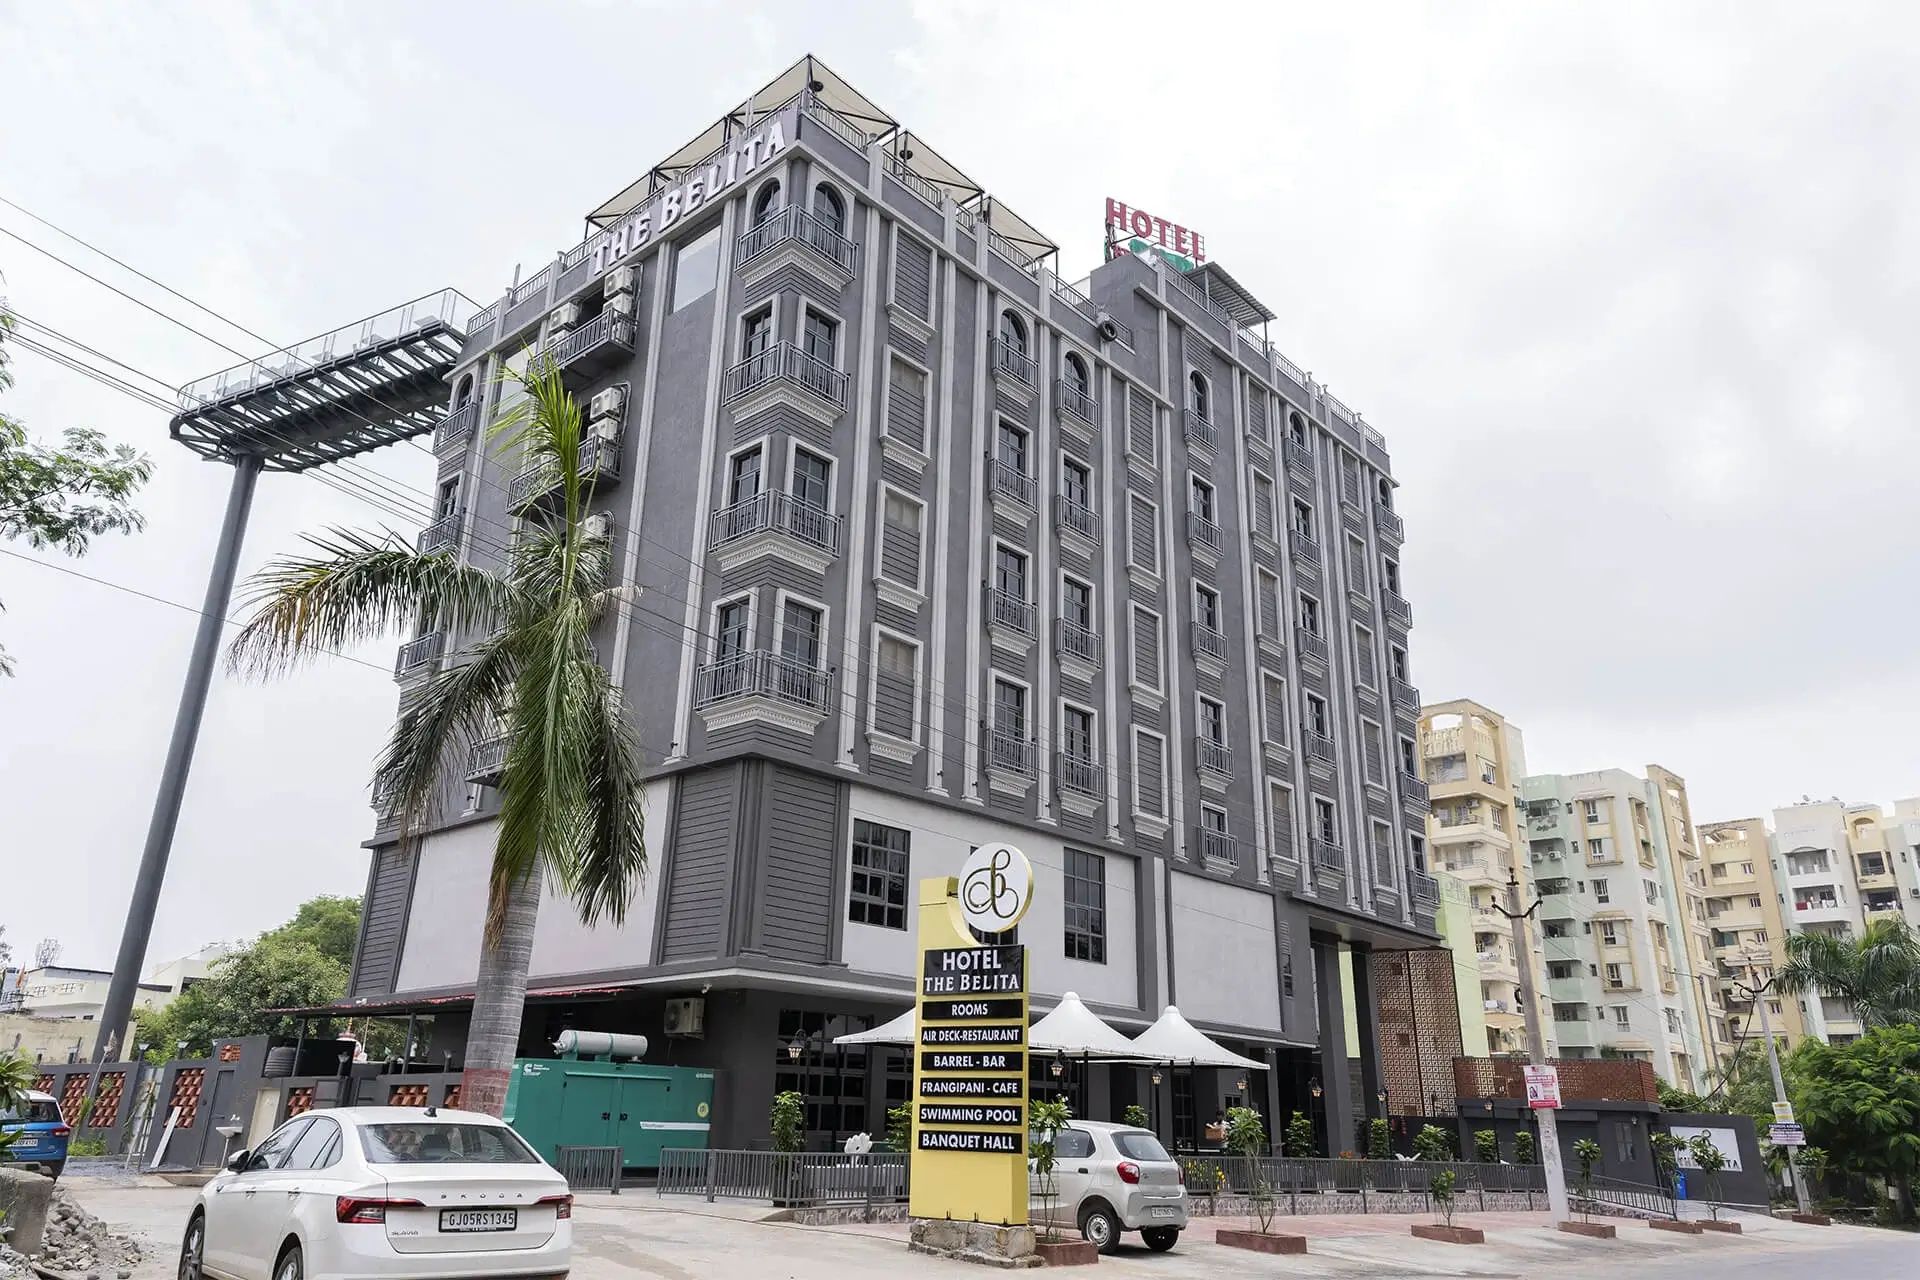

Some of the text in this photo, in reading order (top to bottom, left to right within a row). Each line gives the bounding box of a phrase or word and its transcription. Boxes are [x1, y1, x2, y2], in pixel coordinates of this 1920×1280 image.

[593, 121, 786, 276] THE BELITA
[1105, 197, 1206, 262] HOTEL
[942, 949, 1002, 971] HOTEL
[924, 973, 1019, 992] THE BELITA
[951, 1003, 988, 1016] ROOMS
[922, 1029, 1019, 1041] AIR DECK-RESTAURANT
[933, 1055, 974, 1067] BARREL
[982, 1055, 1006, 1067] BAR
[921, 1082, 985, 1093] FRANGIPANI
[992, 1082, 1018, 1093] CAFE
[920, 1108, 1017, 1122] SWIMMING POOL
[922, 1134, 1014, 1150] BANQUET HALL
[449, 1212, 514, 1226] GJ05RS1345
